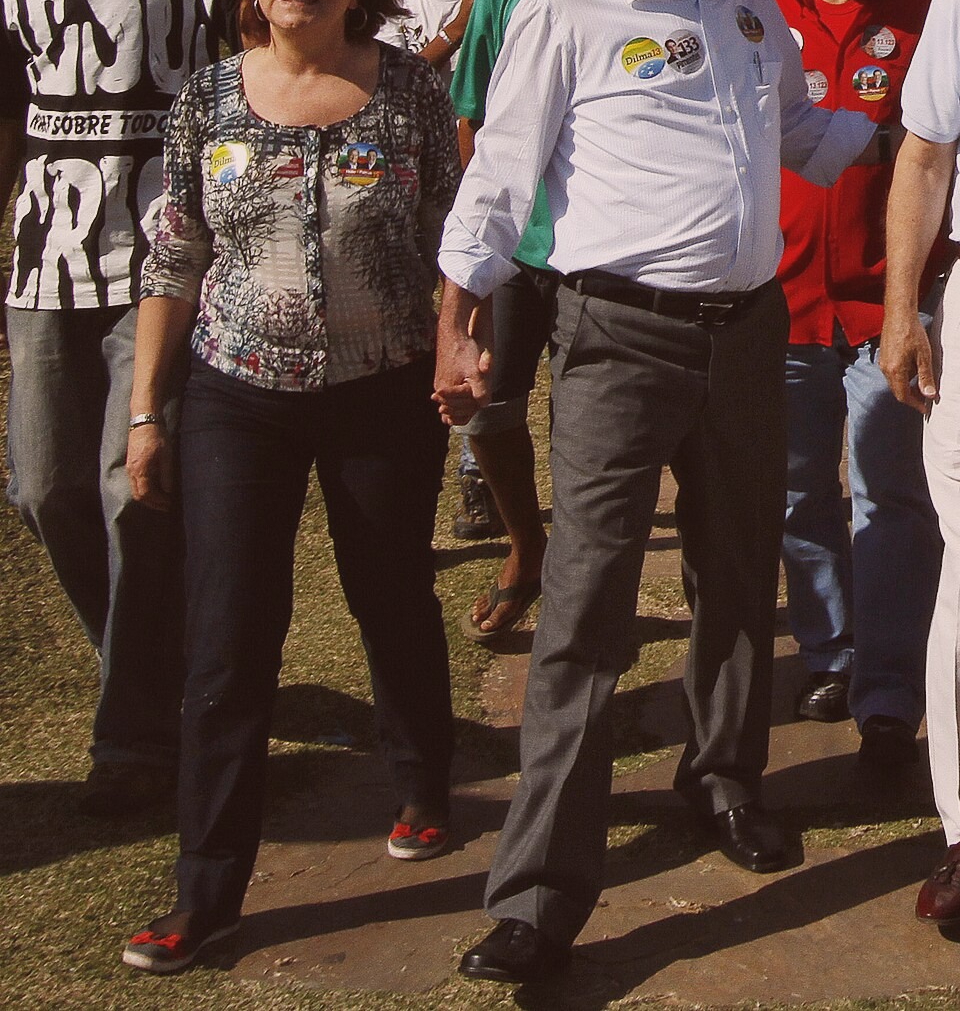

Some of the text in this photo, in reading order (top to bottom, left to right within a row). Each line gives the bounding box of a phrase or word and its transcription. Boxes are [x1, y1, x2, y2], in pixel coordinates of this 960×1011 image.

[678, 37, 699, 55] 133
[625, 47, 662, 65] Dilma13
[51, 114, 112, 135] SOBRE
